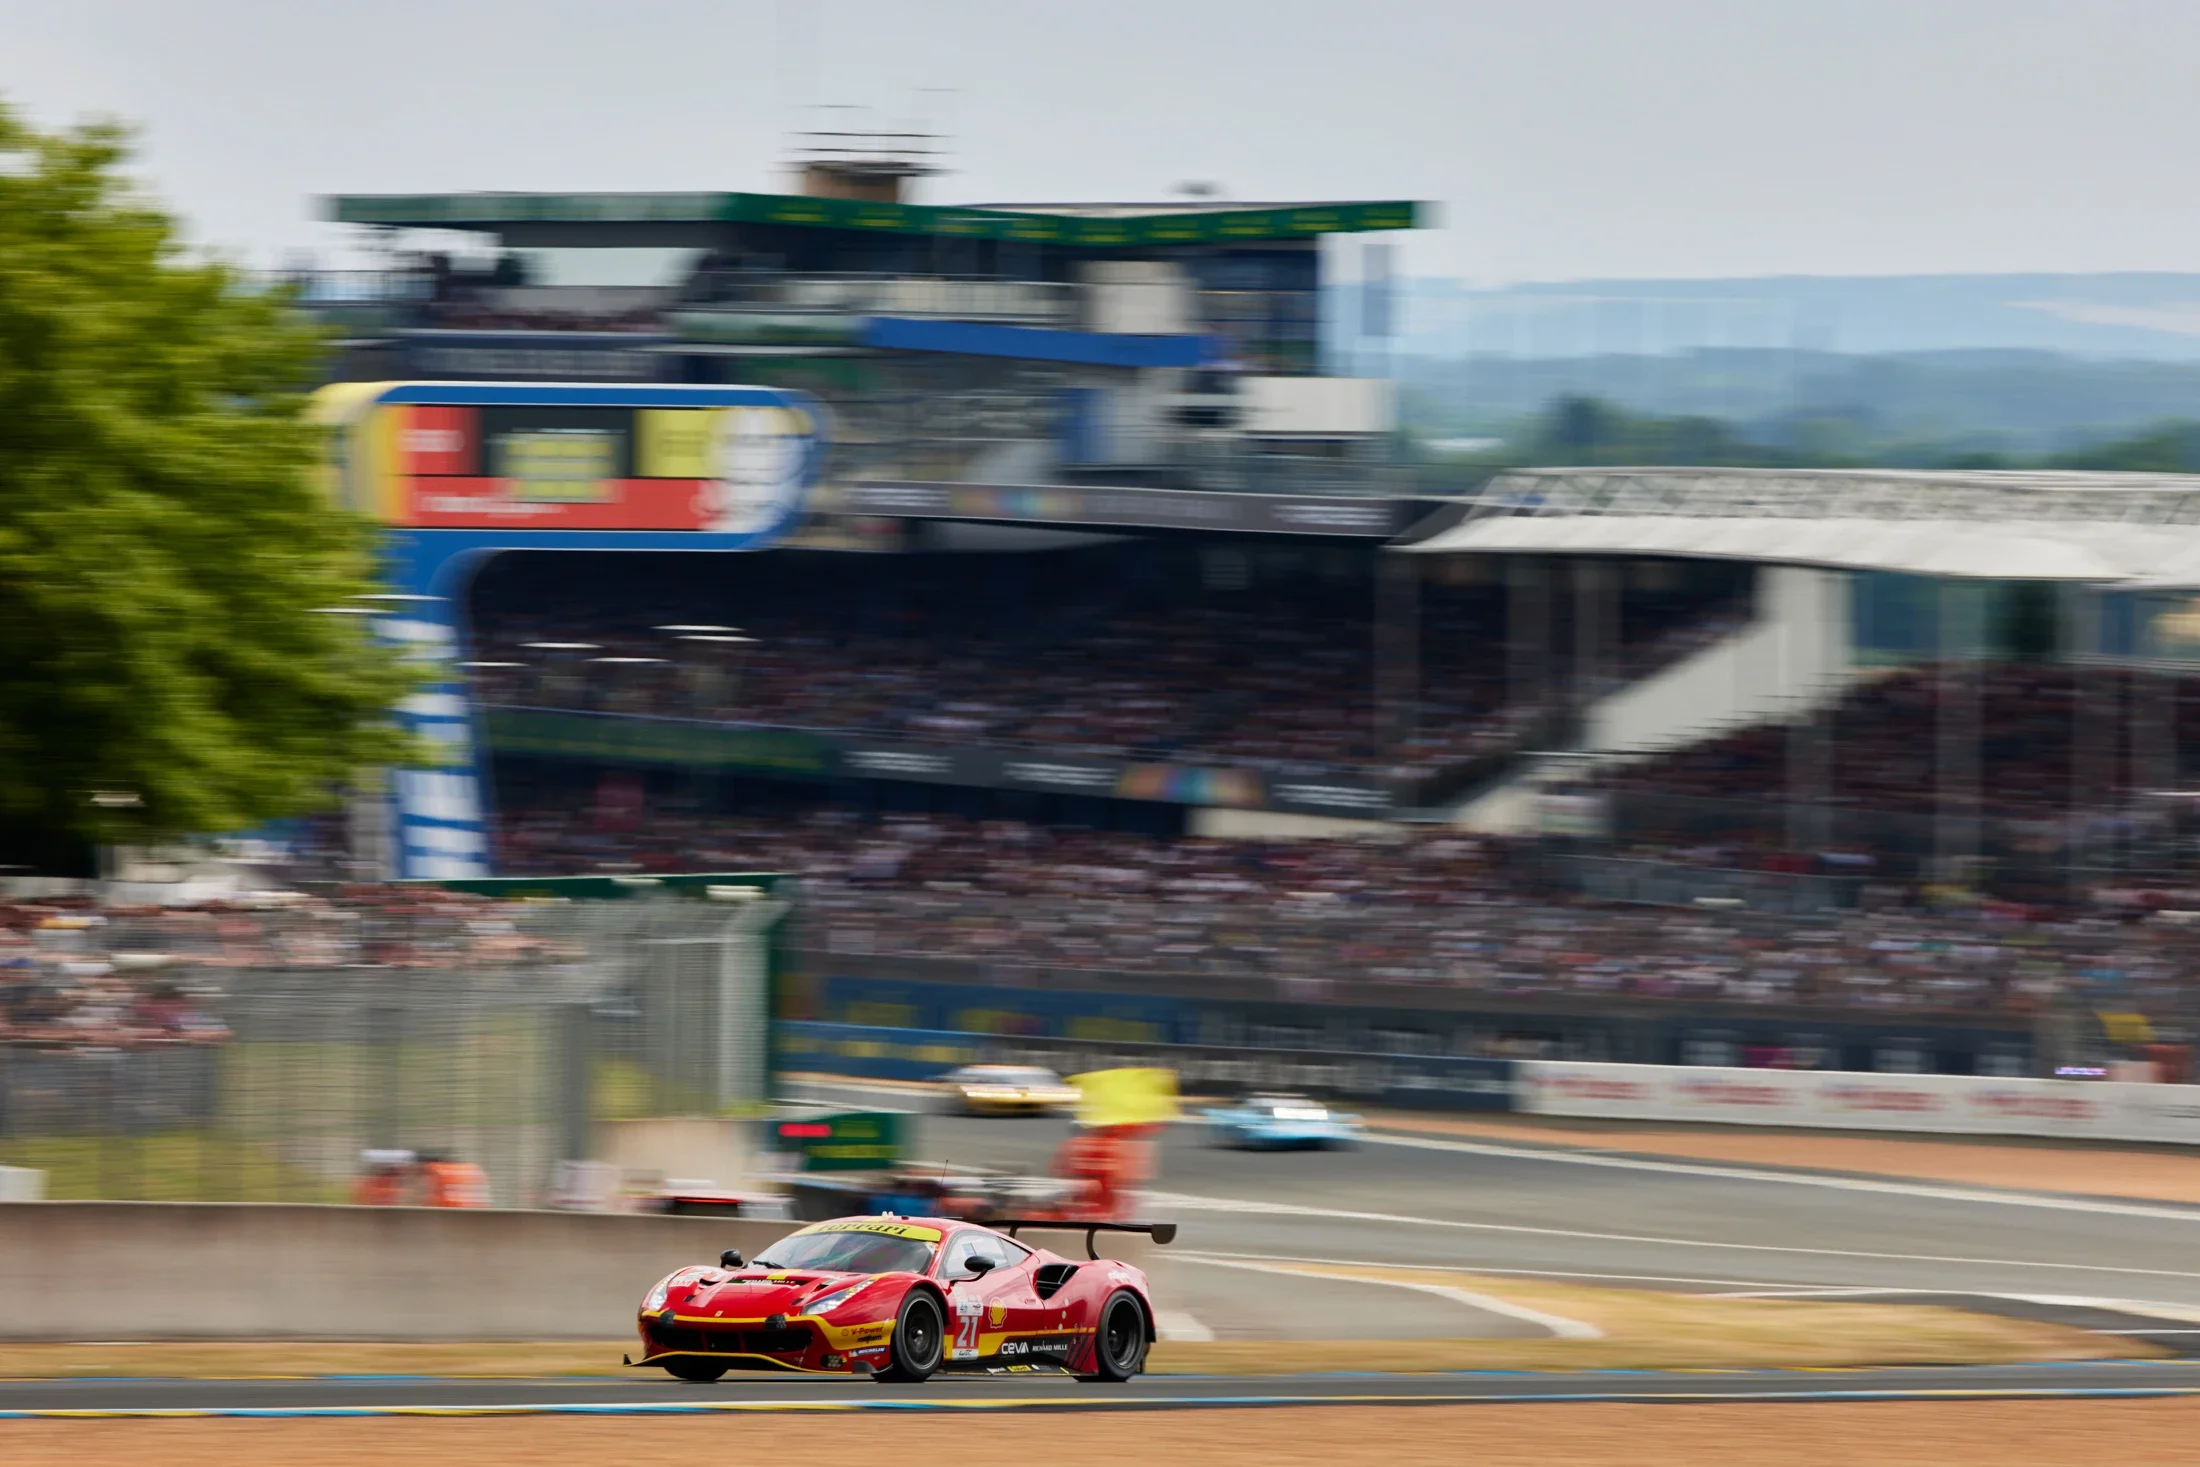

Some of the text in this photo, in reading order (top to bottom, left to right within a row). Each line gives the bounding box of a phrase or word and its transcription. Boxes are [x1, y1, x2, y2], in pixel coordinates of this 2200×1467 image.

[817, 1223, 912, 1235] Ferrari
[851, 1326, 883, 1335] V-Power
[956, 1315, 979, 1347] 21
[1032, 1343, 1053, 1352] RICHARD
